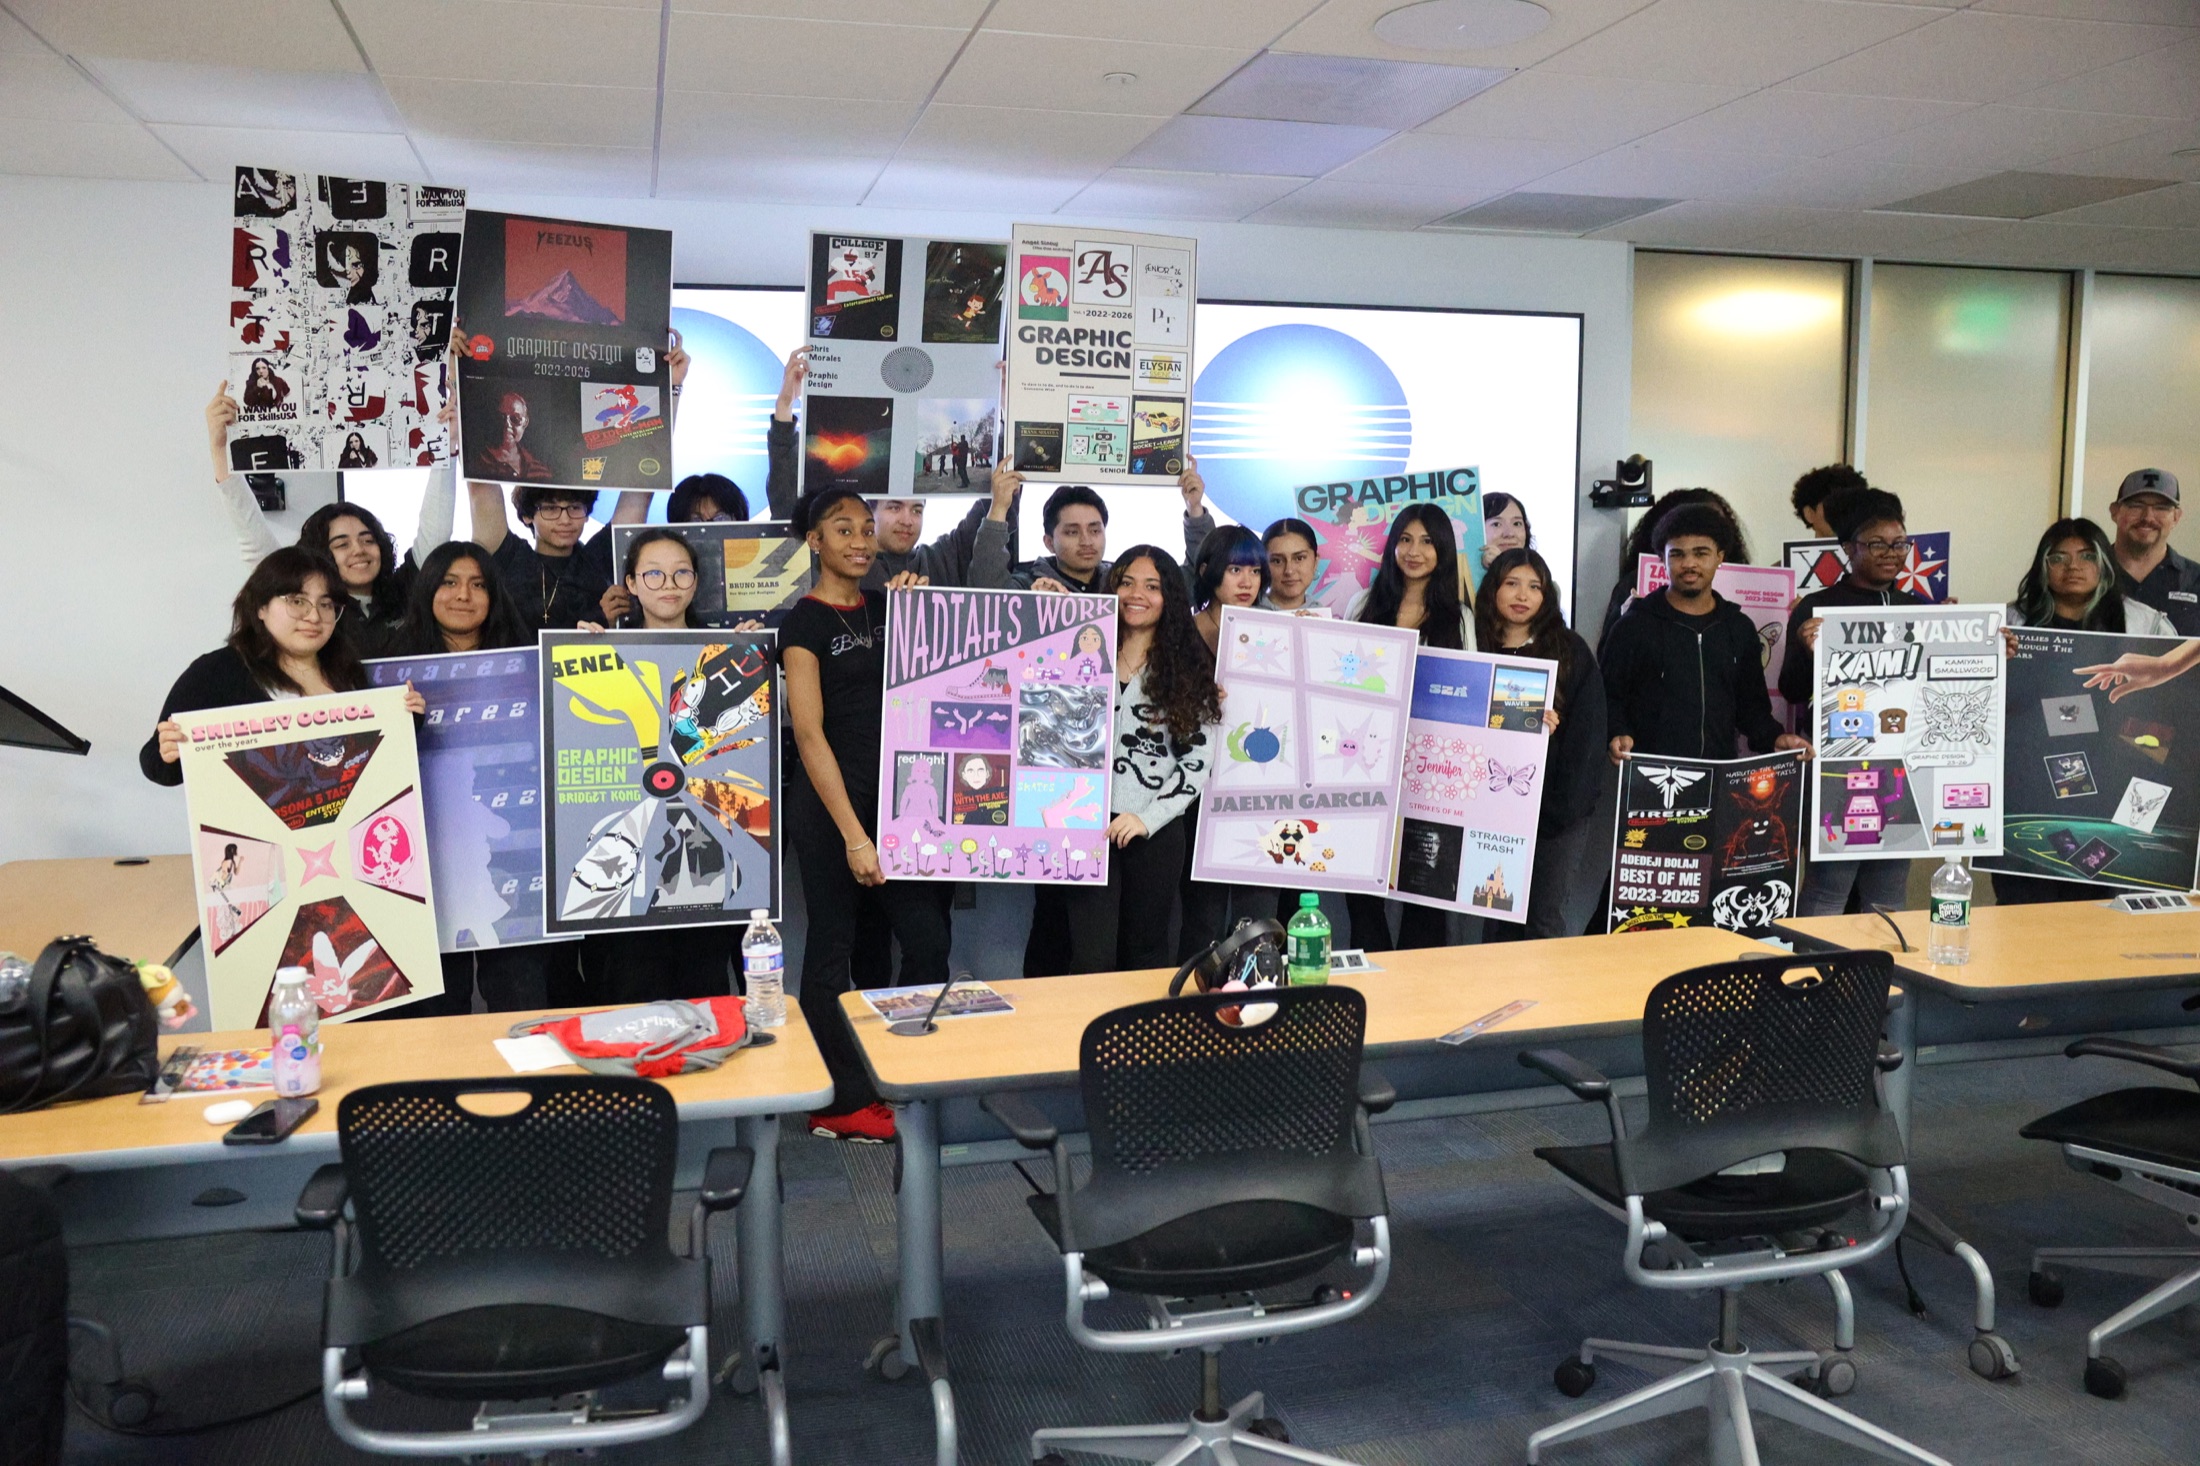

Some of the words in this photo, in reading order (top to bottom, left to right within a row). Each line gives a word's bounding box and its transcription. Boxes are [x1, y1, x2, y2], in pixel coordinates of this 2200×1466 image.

[537, 231, 593, 256] YEEZUS
[832, 238, 884, 251] COLLEGE
[864, 251, 878, 259] 97
[1086, 310, 1133, 319] 2022-2026
[1018, 325, 1132, 349] GRAPHIC
[809, 354, 841, 362] Morales
[1036, 347, 1131, 369] DESIGN
[1139, 361, 1182, 372] ELYSIAN
[808, 371, 839, 380] Graphic
[807, 380, 833, 389] Design
[274, 403, 297, 413] YOU
[2143, 474, 2159, 488] T
[1297, 468, 1477, 514] GRAPHIC
[890, 591, 1023, 686] NADIAH'S
[1036, 596, 1114, 635] WORK
[1841, 621, 1887, 644] YIN
[2015, 634, 2049, 643] ATALIES
[1827, 643, 1923, 686] KAM!
[1945, 658, 1984, 666] KAMIYAH
[1934, 666, 1994, 675] SMALLWOOD
[1428, 683, 1468, 698] SZA
[191, 714, 292, 743] SHIRLEY
[296, 704, 375, 727] OCHOA
[195, 743, 215, 752] over
[218, 739, 232, 748] the
[235, 737, 259, 749] years
[558, 747, 638, 766] GRAPHIC
[897, 754, 916, 767] red
[1417, 755, 1463, 778] Jennifer
[1776, 768, 1797, 777] TAILS
[558, 766, 626, 785] DESIGN
[315, 793, 323, 804] 5
[559, 791, 607, 804] BRIDGET
[610, 789, 642, 803] KONG
[954, 794, 975, 806] WITH
[975, 793, 990, 803] THE
[1210, 794, 1294, 813] JAELYN
[1299, 791, 1388, 810] GARCIA
[1409, 802, 1441, 815] STROKES
[1442, 807, 1452, 816] OF
[1628, 808, 1712, 818] FIREFLY
[1470, 830, 1527, 846] STRAIGHT
[1477, 841, 1515, 855] TRASH
[1621, 854, 1662, 867] ADEDEJI
[1664, 857, 1699, 869] BOLAJI
[1620, 868, 1654, 884] BEST
[1657, 871, 1676, 885] OF
[1679, 872, 1701, 886] ME
[1618, 886, 1700, 904] 2023-2025
